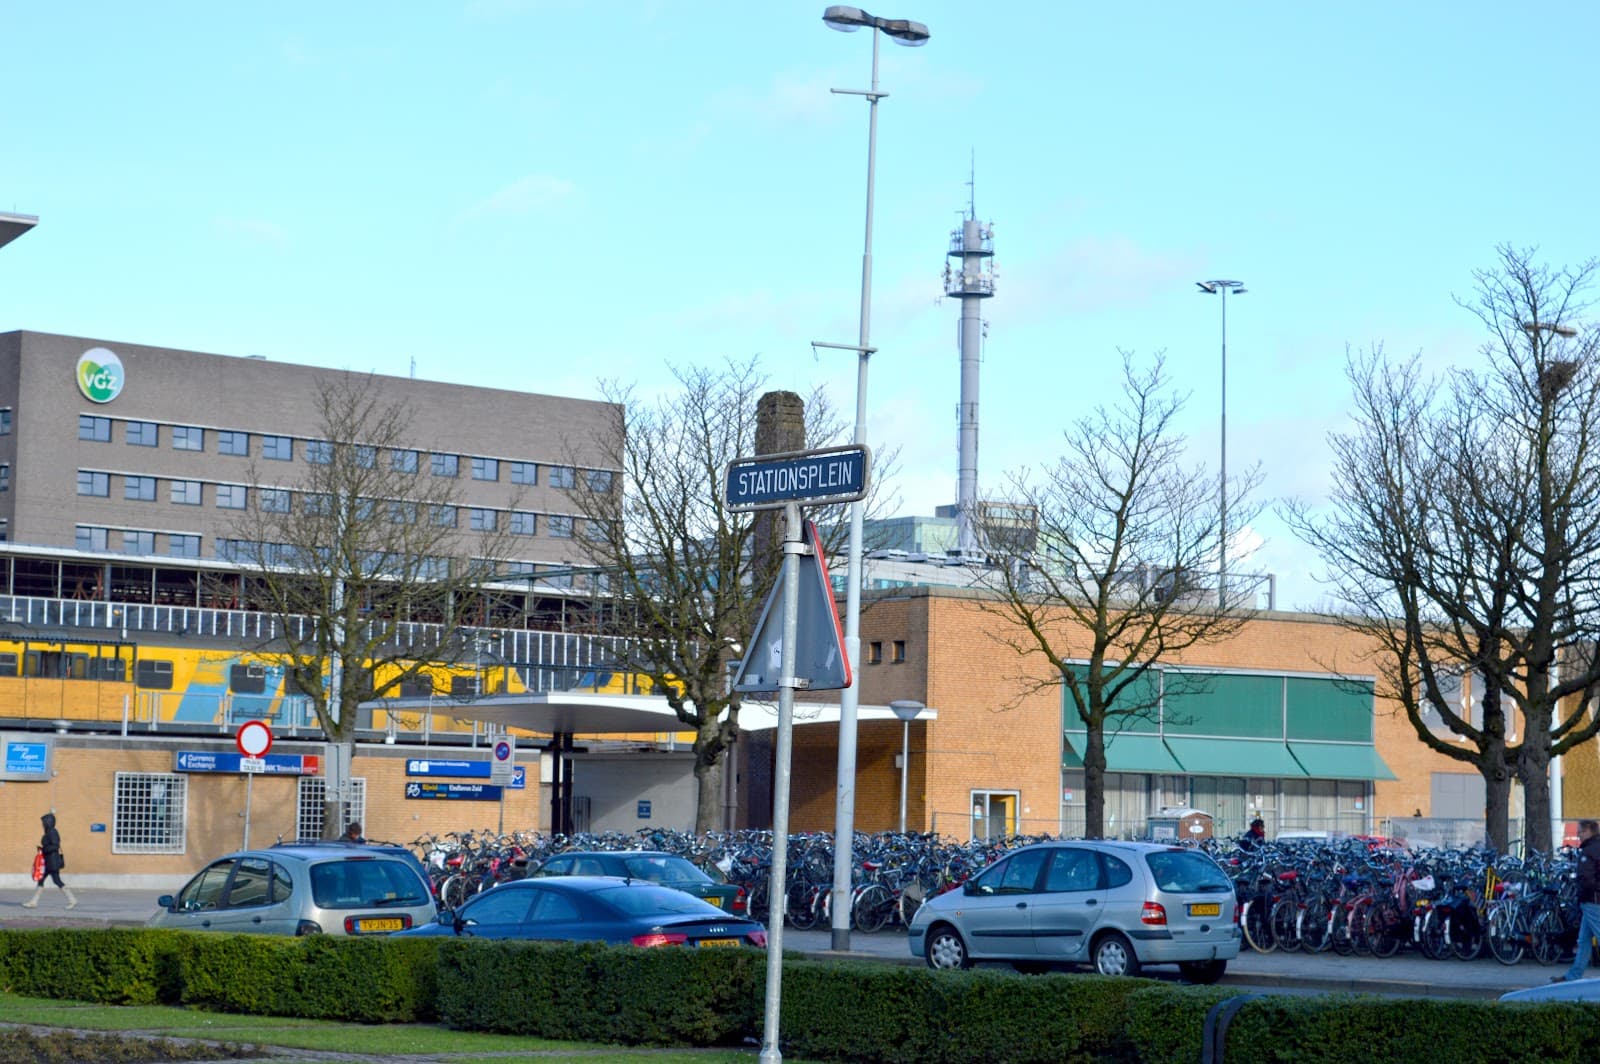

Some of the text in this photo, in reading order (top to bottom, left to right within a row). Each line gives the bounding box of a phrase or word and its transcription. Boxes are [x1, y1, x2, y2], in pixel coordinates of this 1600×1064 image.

[83, 370, 118, 390] VGZ
[739, 461, 853, 496] STATIONSPLEIN
[188, 754, 216, 763] Currency
[188, 761, 216, 770] Exchange
